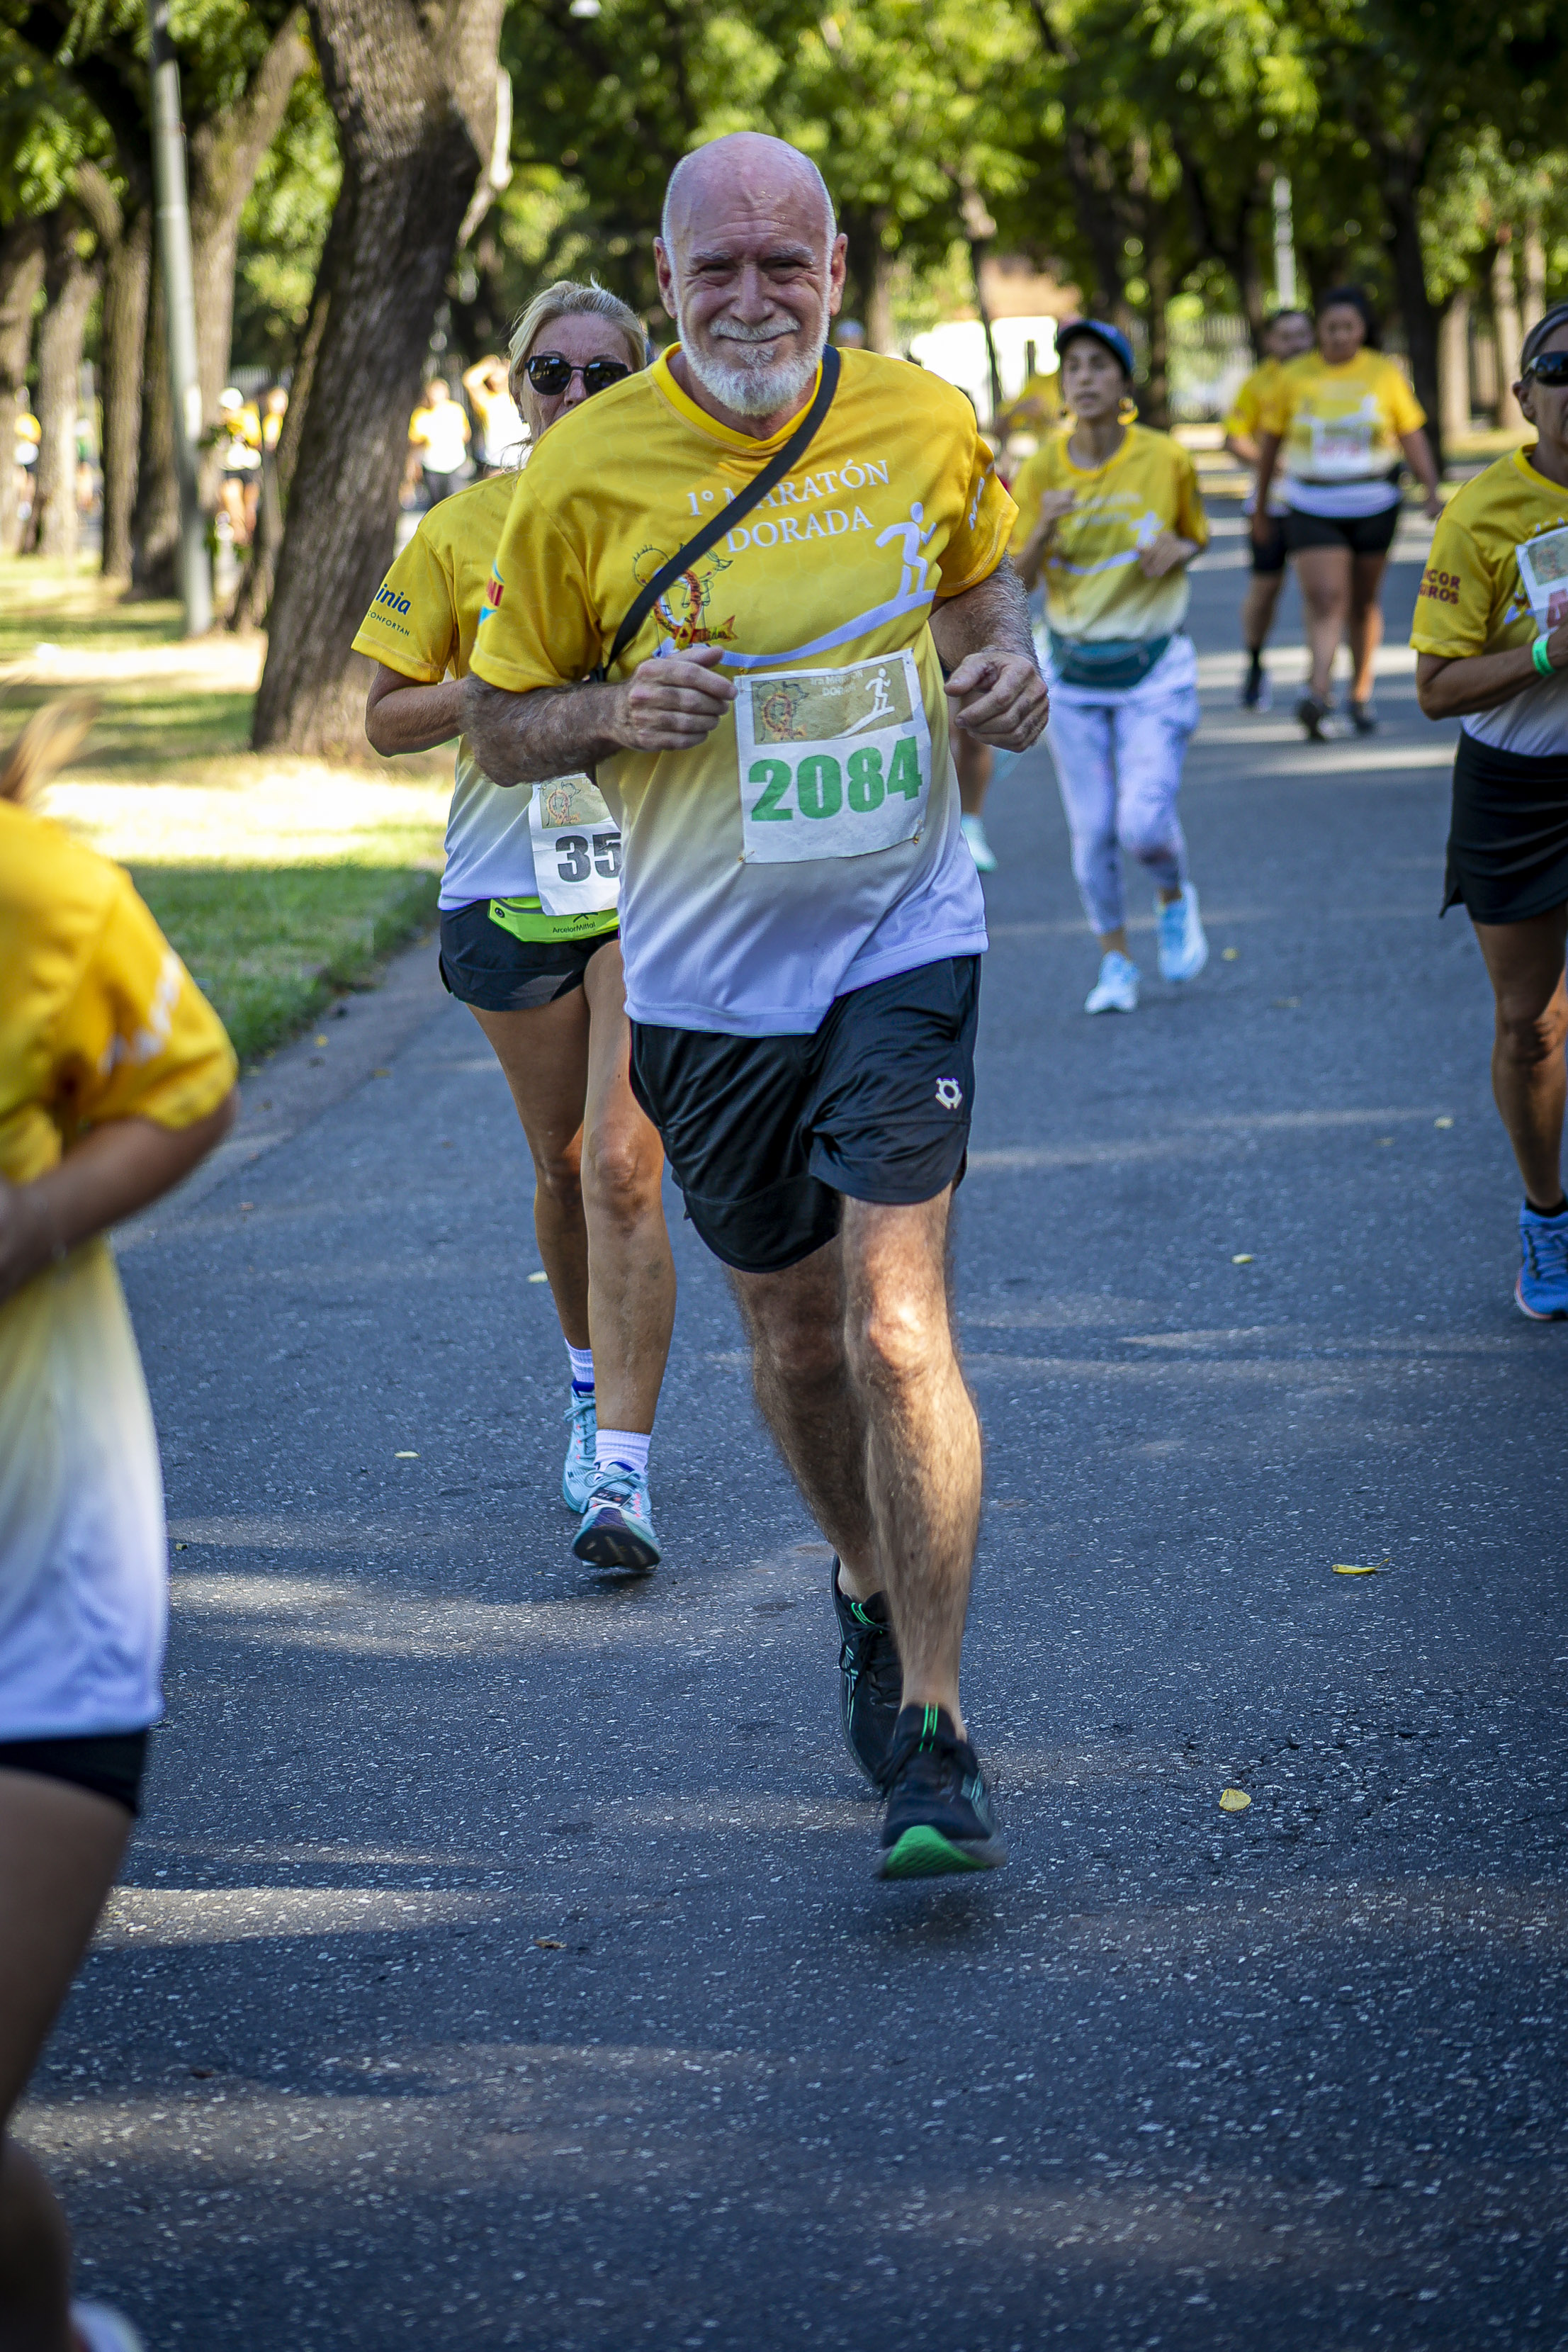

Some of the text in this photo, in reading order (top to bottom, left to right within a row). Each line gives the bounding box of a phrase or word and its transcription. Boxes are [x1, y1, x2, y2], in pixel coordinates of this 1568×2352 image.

[726, 505, 875, 553] DORADA
[748, 736, 923, 822] 2084
[555, 832, 621, 883] 35
